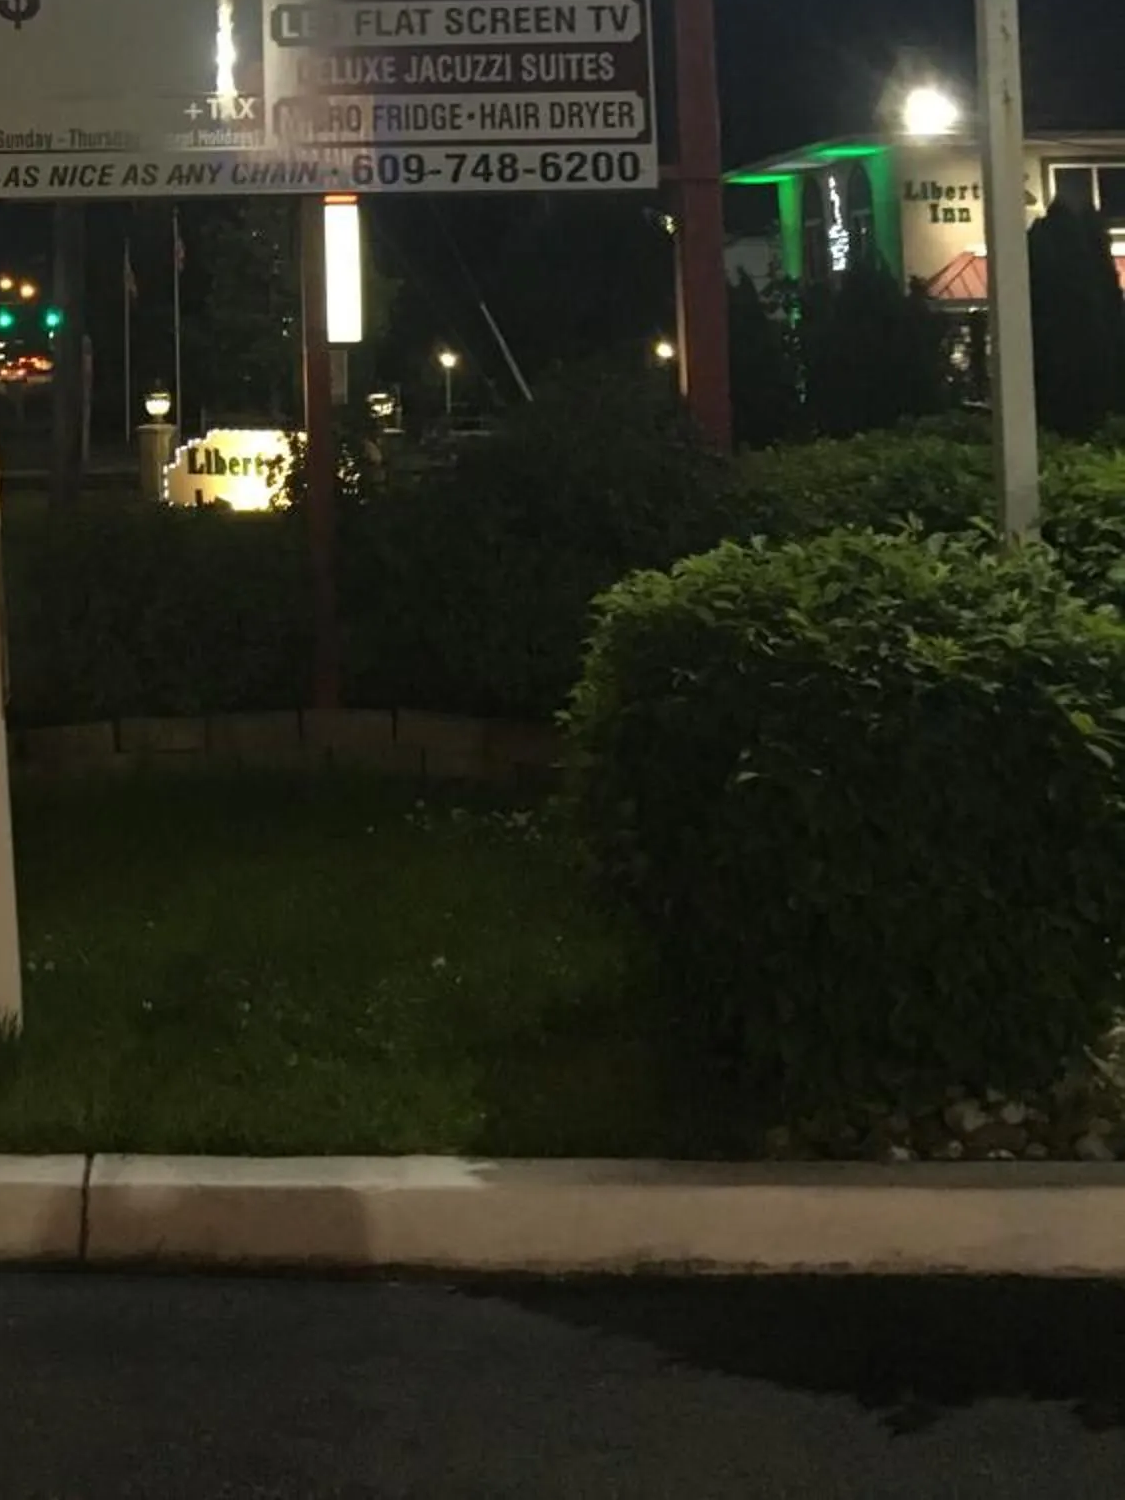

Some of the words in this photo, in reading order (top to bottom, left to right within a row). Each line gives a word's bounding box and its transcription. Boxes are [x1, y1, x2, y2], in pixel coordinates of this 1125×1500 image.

[354, 8, 433, 37] FLAT
[445, 5, 577, 35] SCREEN
[586, 4, 631, 33] TV
[403, 53, 512, 84] JACUZZI
[520, 51, 616, 82] SUITES
[549, 100, 636, 129] DRYER
[3, 165, 41, 189] AS
[48, 163, 118, 188] NICE
[120, 162, 161, 186] AS
[165, 162, 224, 186] ANY
[230, 160, 319, 186] CHAIN
[351, 151, 642, 186] 609-748-6200
[903, 180, 982, 201] Libert
[929, 202, 972, 222] Inn
